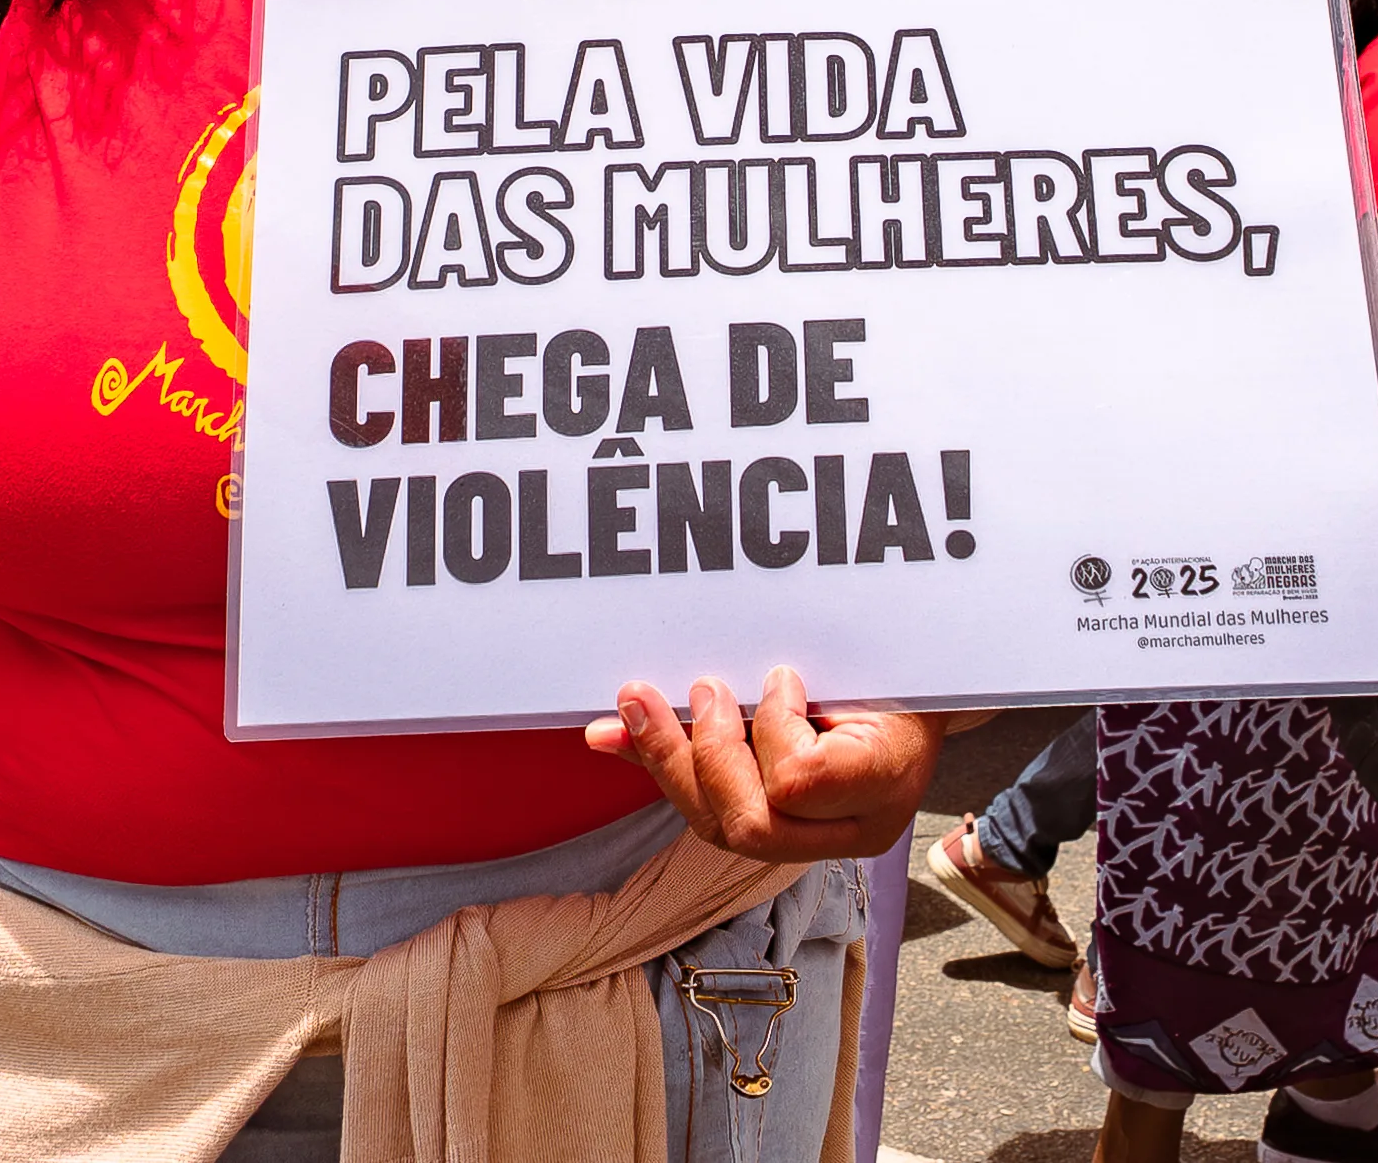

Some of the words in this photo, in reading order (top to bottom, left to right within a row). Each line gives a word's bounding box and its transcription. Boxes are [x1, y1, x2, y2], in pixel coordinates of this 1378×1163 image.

[337, 40, 645, 163] PELA
[672, 27, 967, 145] VIDA
[330, 166, 575, 295] DAS
[603, 144, 1281, 280] MULHERES,
[328, 325, 695, 449] CHEGA
[727, 318, 871, 429] DE
[326, 437, 978, 591] VIOLÊNCIA!
[1264, 556, 1297, 565] MARCHA
[1265, 564, 1315, 575] MULHERES
[1266, 575, 1317, 588] NEGRAS
[1077, 613, 1139, 632] Marcha
[1144, 611, 1212, 630] Mundial
[1216, 610, 1246, 627] das
[1250, 607, 1329, 626] Mulheres
[1137, 632, 1266, 650] @marchamulheres
